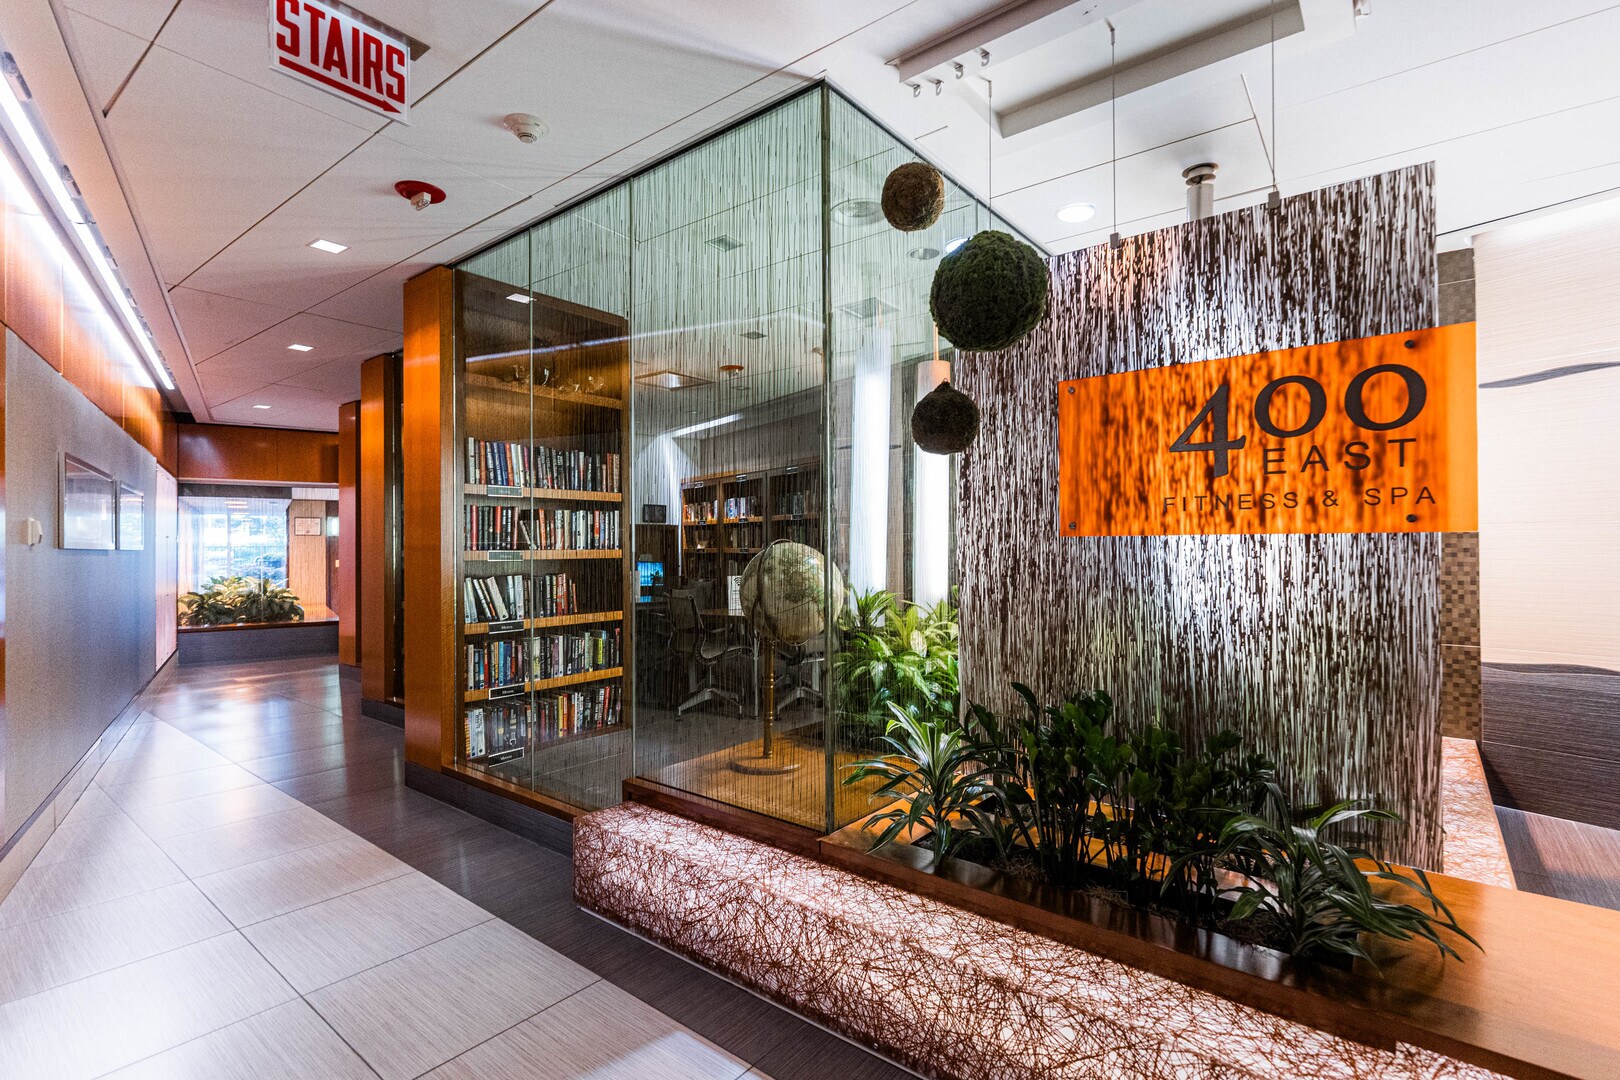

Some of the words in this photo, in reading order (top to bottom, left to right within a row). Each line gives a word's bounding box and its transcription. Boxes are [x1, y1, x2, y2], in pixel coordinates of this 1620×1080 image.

[276, 0, 405, 104] STAIRS
[1169, 363, 1427, 478] 400
[1263, 437, 1417, 475] EAST
[1162, 491, 1300, 512] FITNESS
[1322, 489, 1340, 507] &
[1364, 486, 1437, 506] SPA
